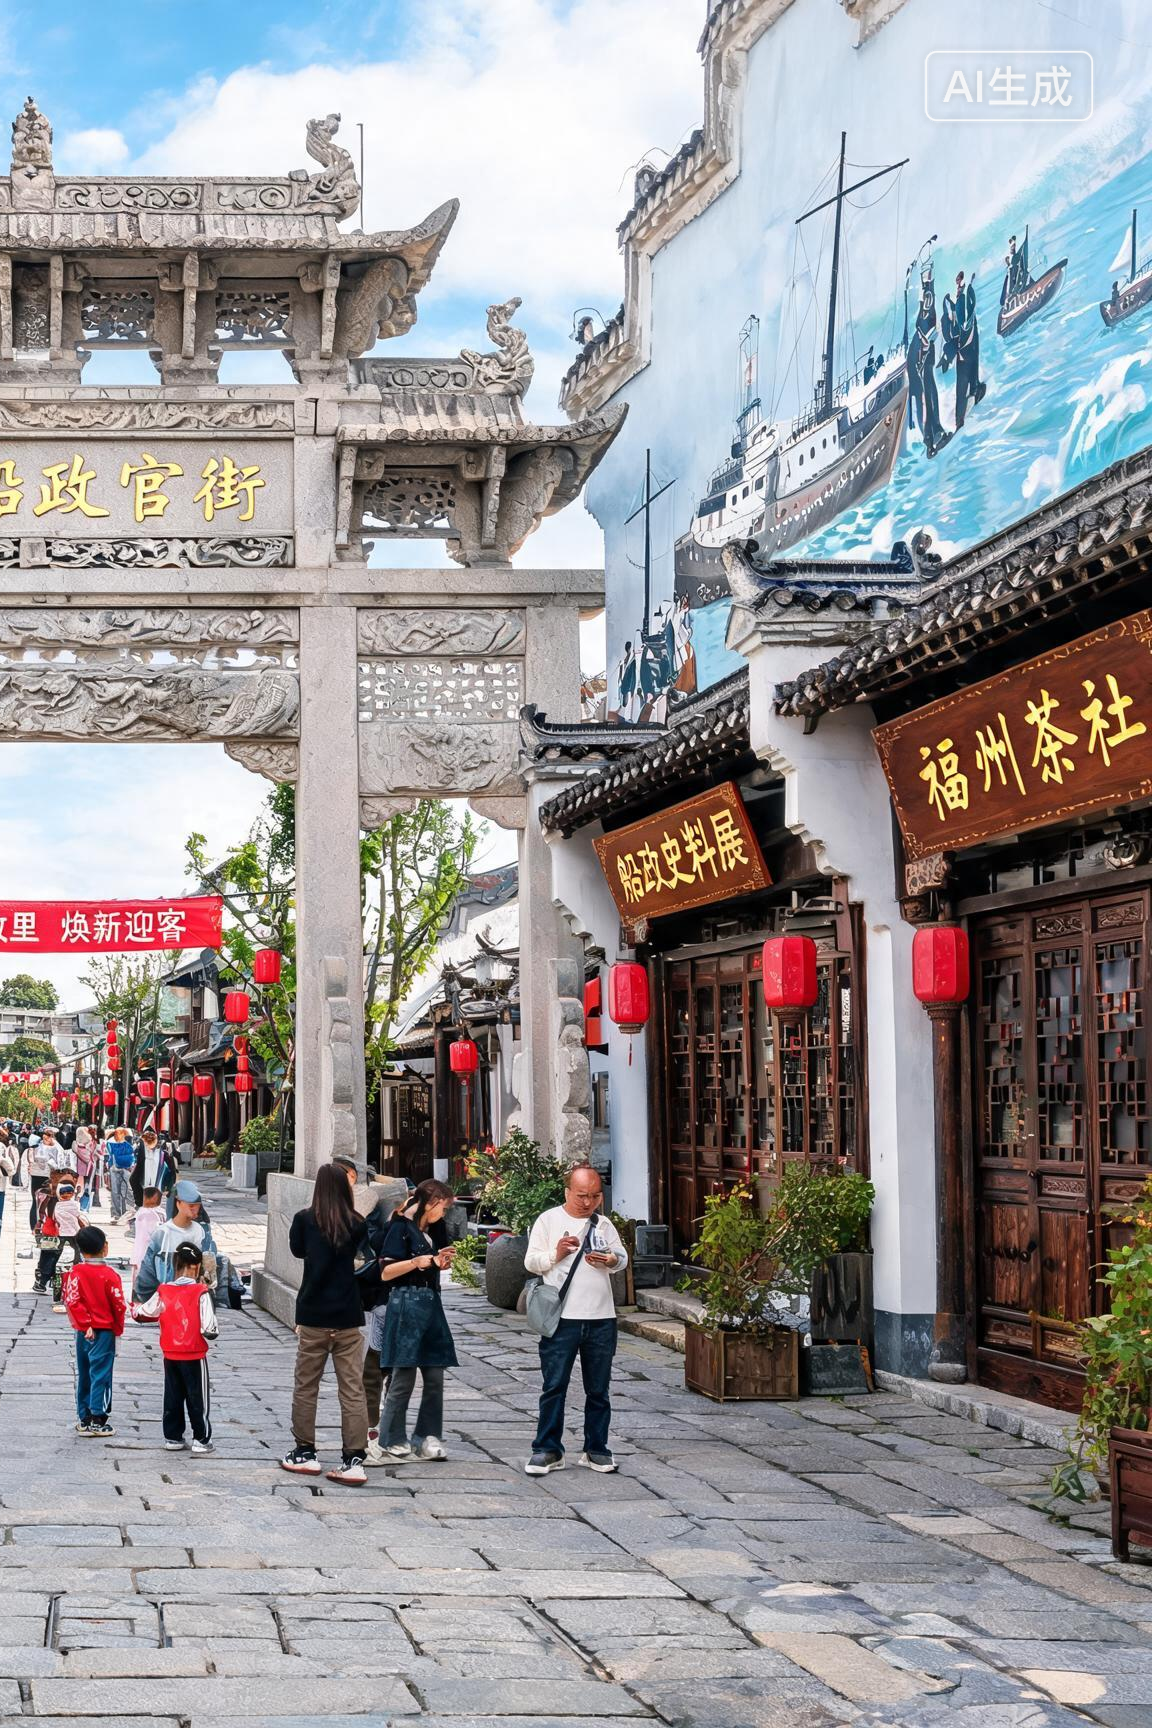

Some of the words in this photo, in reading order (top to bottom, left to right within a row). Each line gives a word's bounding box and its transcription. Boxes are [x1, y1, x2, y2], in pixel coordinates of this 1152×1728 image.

[919, 673, 1147, 822] 福州茶社
[617, 808, 749, 903] 船政史料展
[61, 908, 186, 944] 焕新迎客
